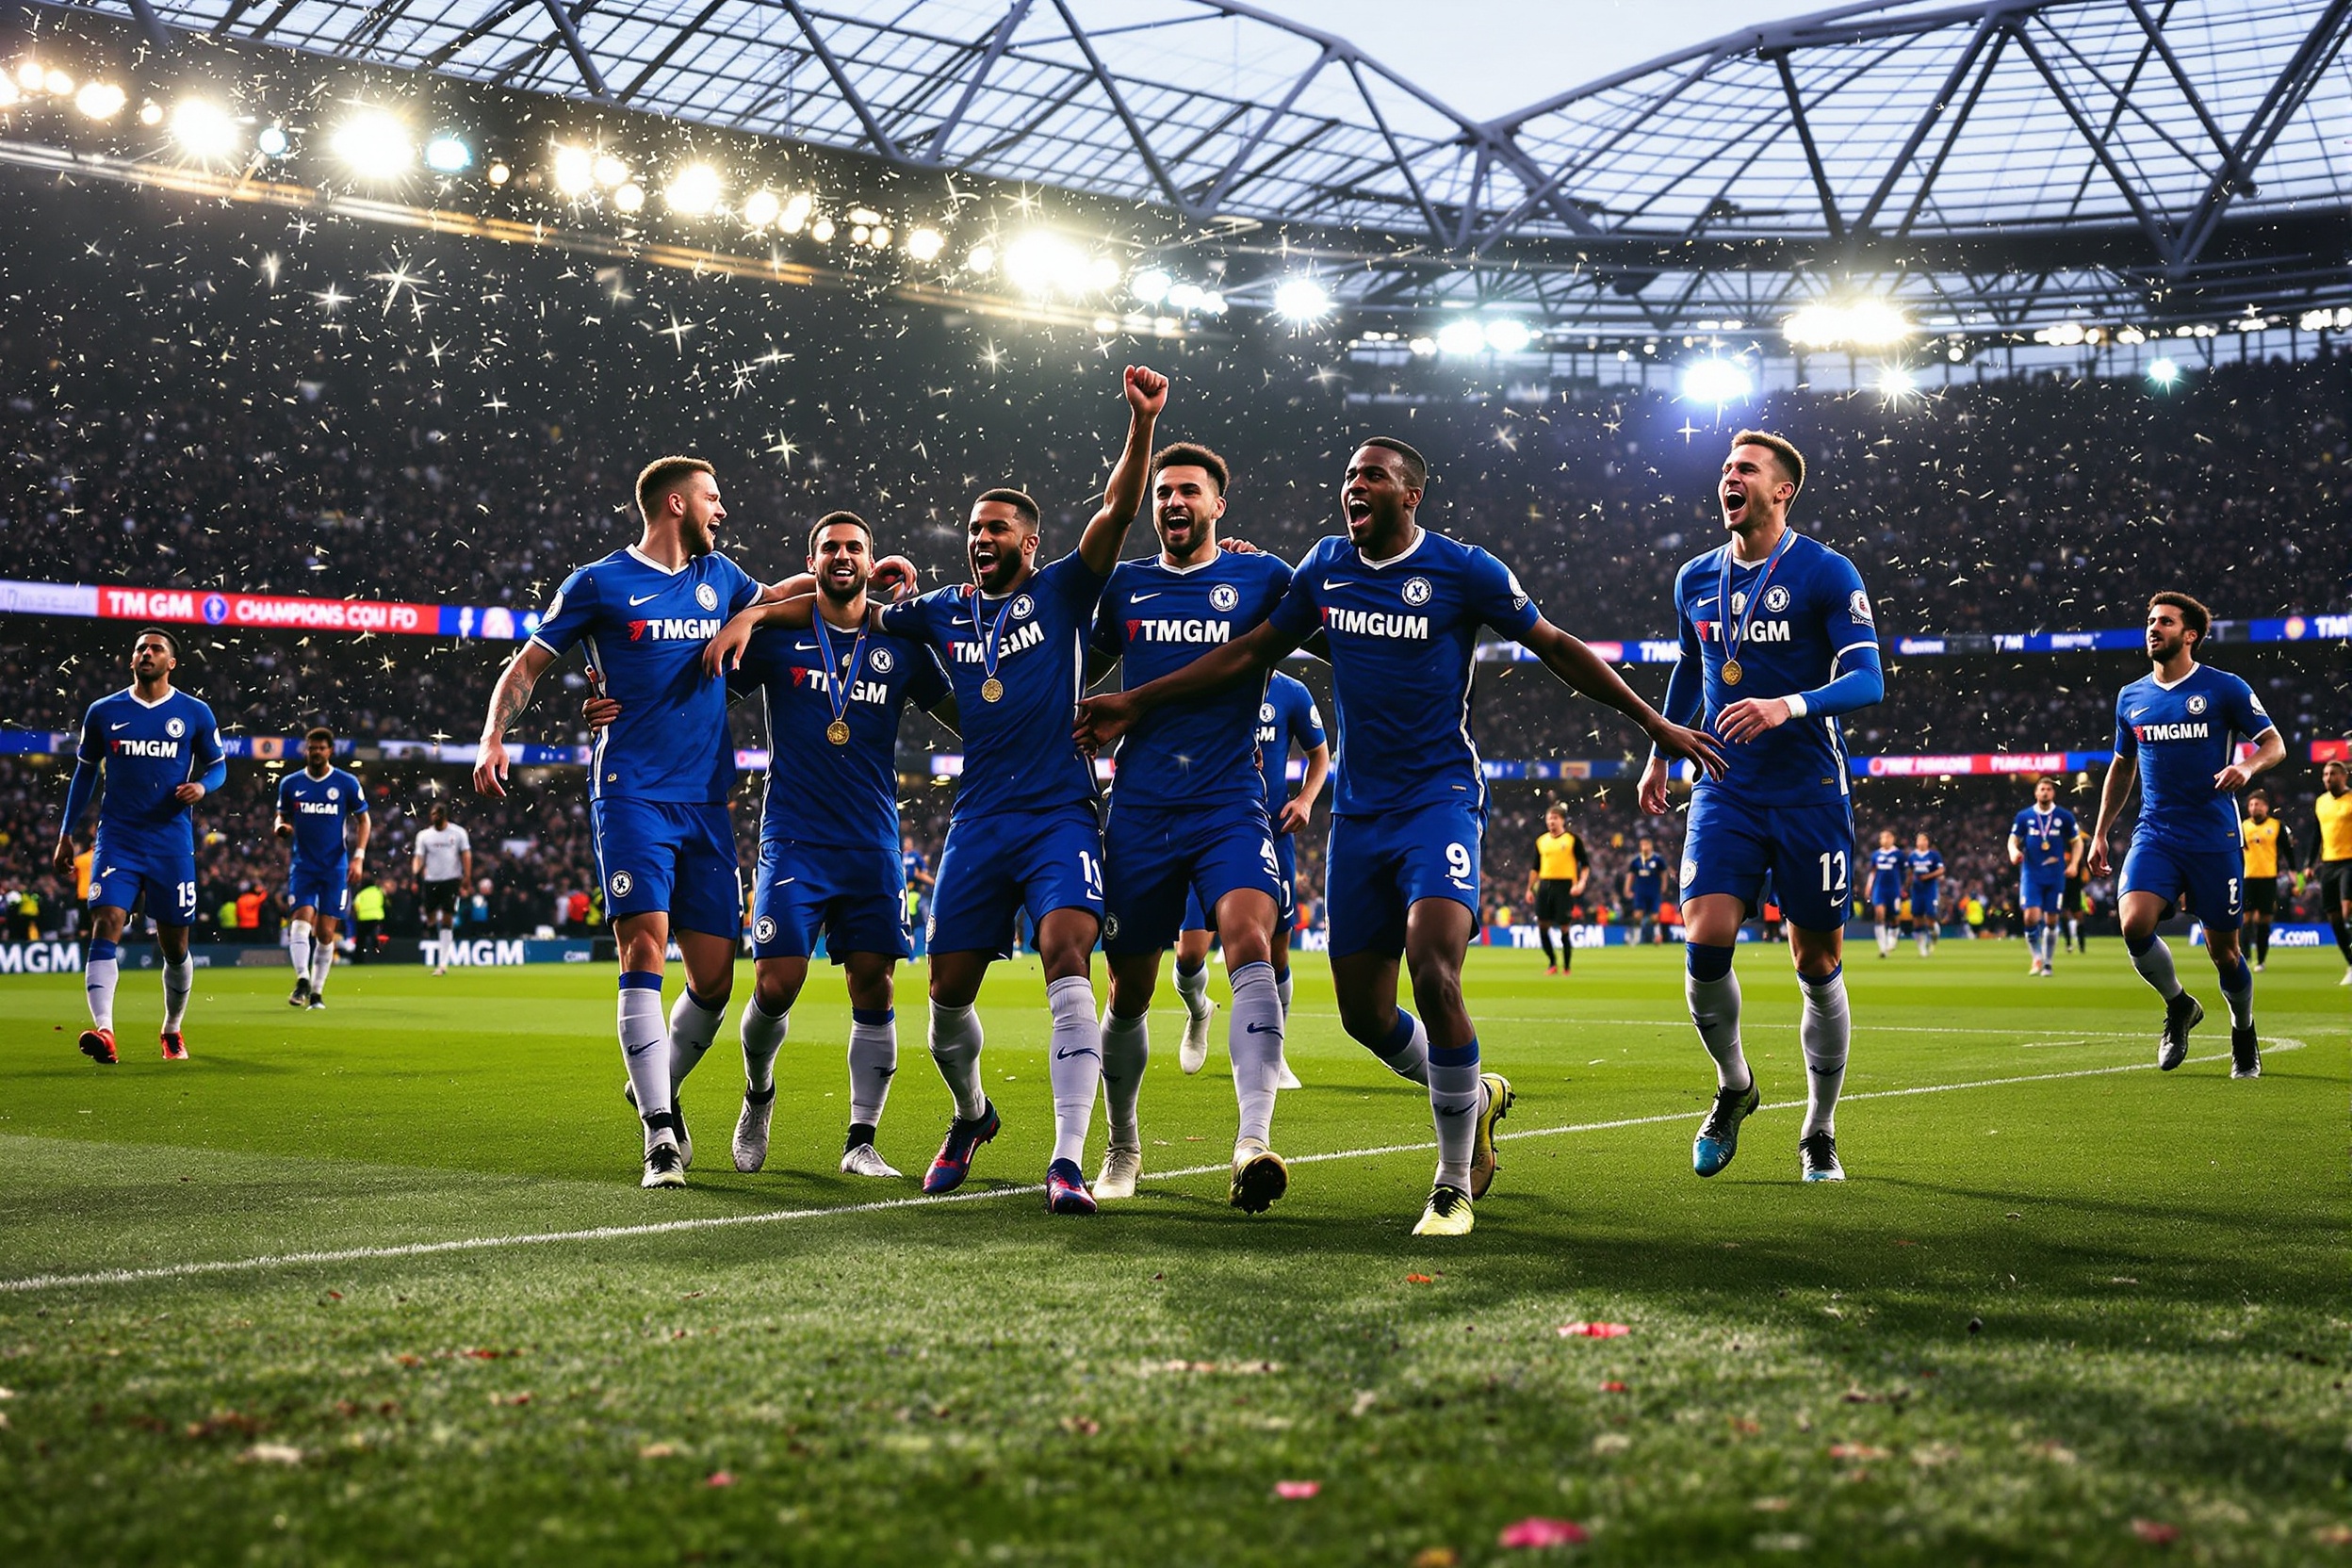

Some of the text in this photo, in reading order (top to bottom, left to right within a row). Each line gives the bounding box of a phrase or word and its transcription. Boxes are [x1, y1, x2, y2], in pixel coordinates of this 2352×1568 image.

[1141, 619, 1231, 644] TMGM
[1328, 606, 1429, 640] TIMGUM
[119, 740, 179, 759] TMGM
[1446, 842, 1471, 878] 9
[1819, 849, 1847, 891] 12
